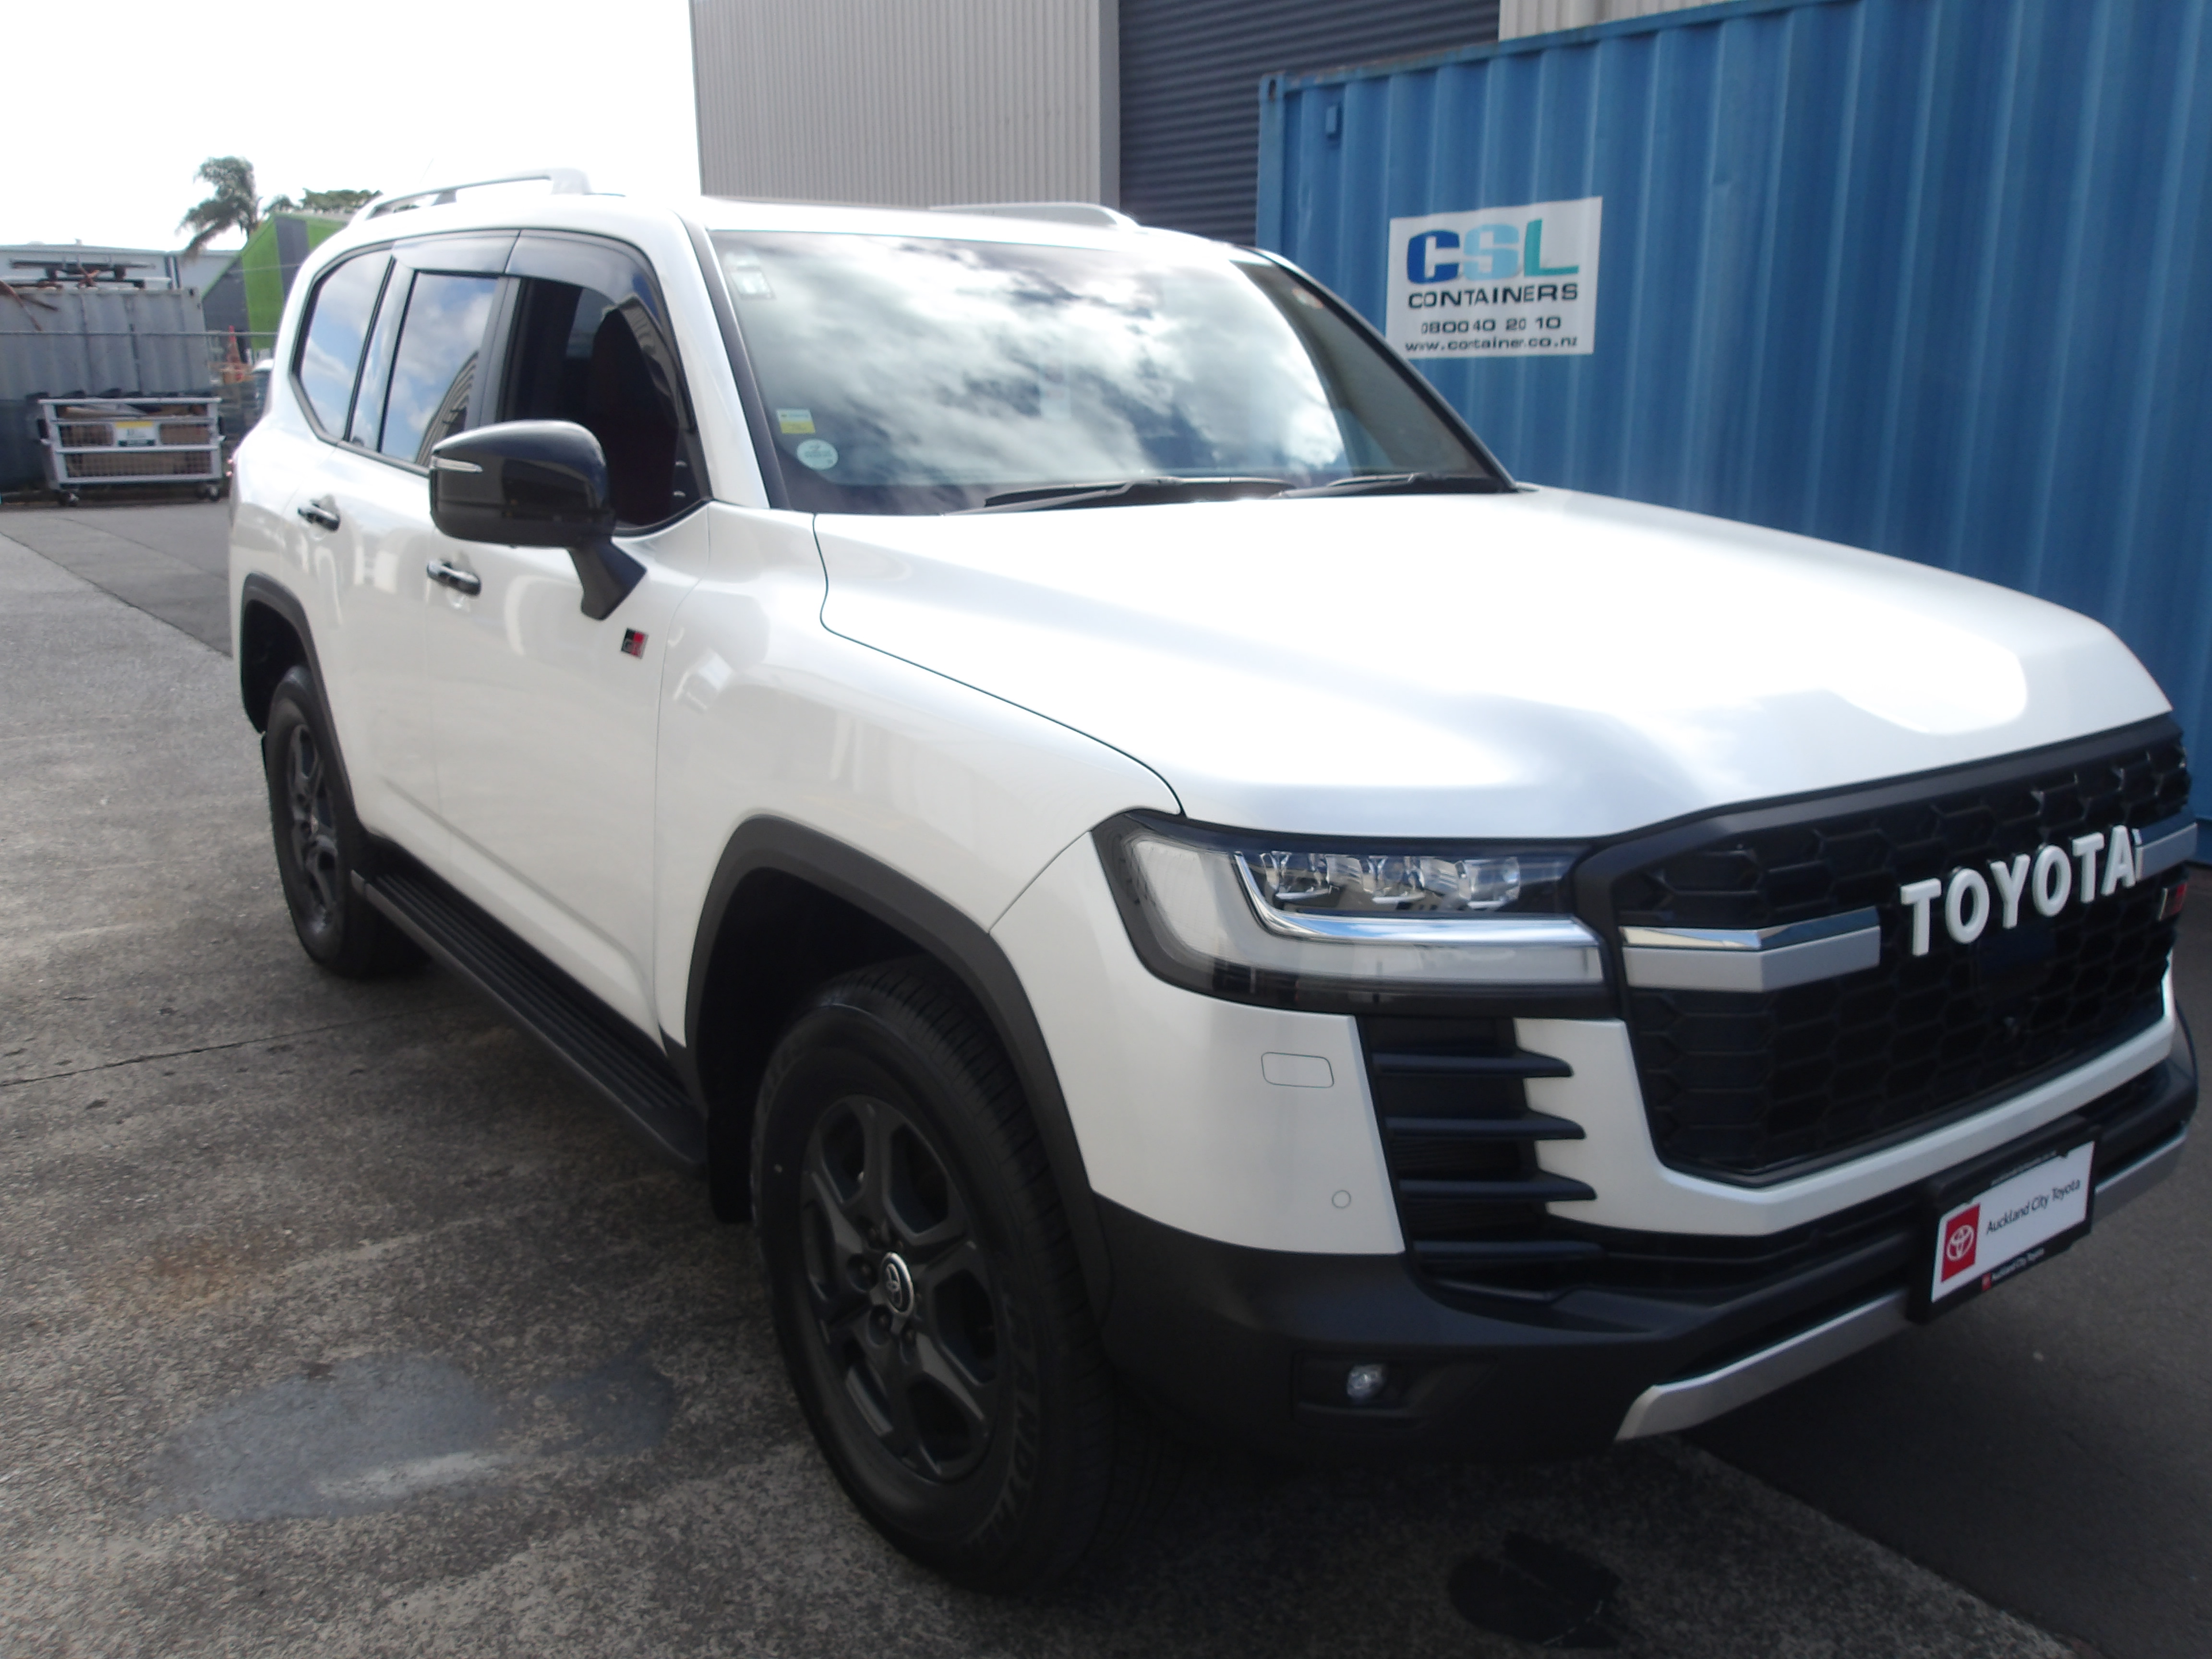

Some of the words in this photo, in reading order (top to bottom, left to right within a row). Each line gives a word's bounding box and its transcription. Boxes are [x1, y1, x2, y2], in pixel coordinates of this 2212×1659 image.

[1407, 218, 1579, 285] CSL
[1408, 282, 1578, 309] CONTAINERS
[1505, 318, 1527, 331] 20
[1536, 316, 1561, 330] 10
[1900, 825, 2136, 957] TOYOTA
[1986, 1200, 2031, 1235] Auckland
[2031, 1194, 2050, 1210] City
[2051, 1179, 2081, 1201] Toyota
